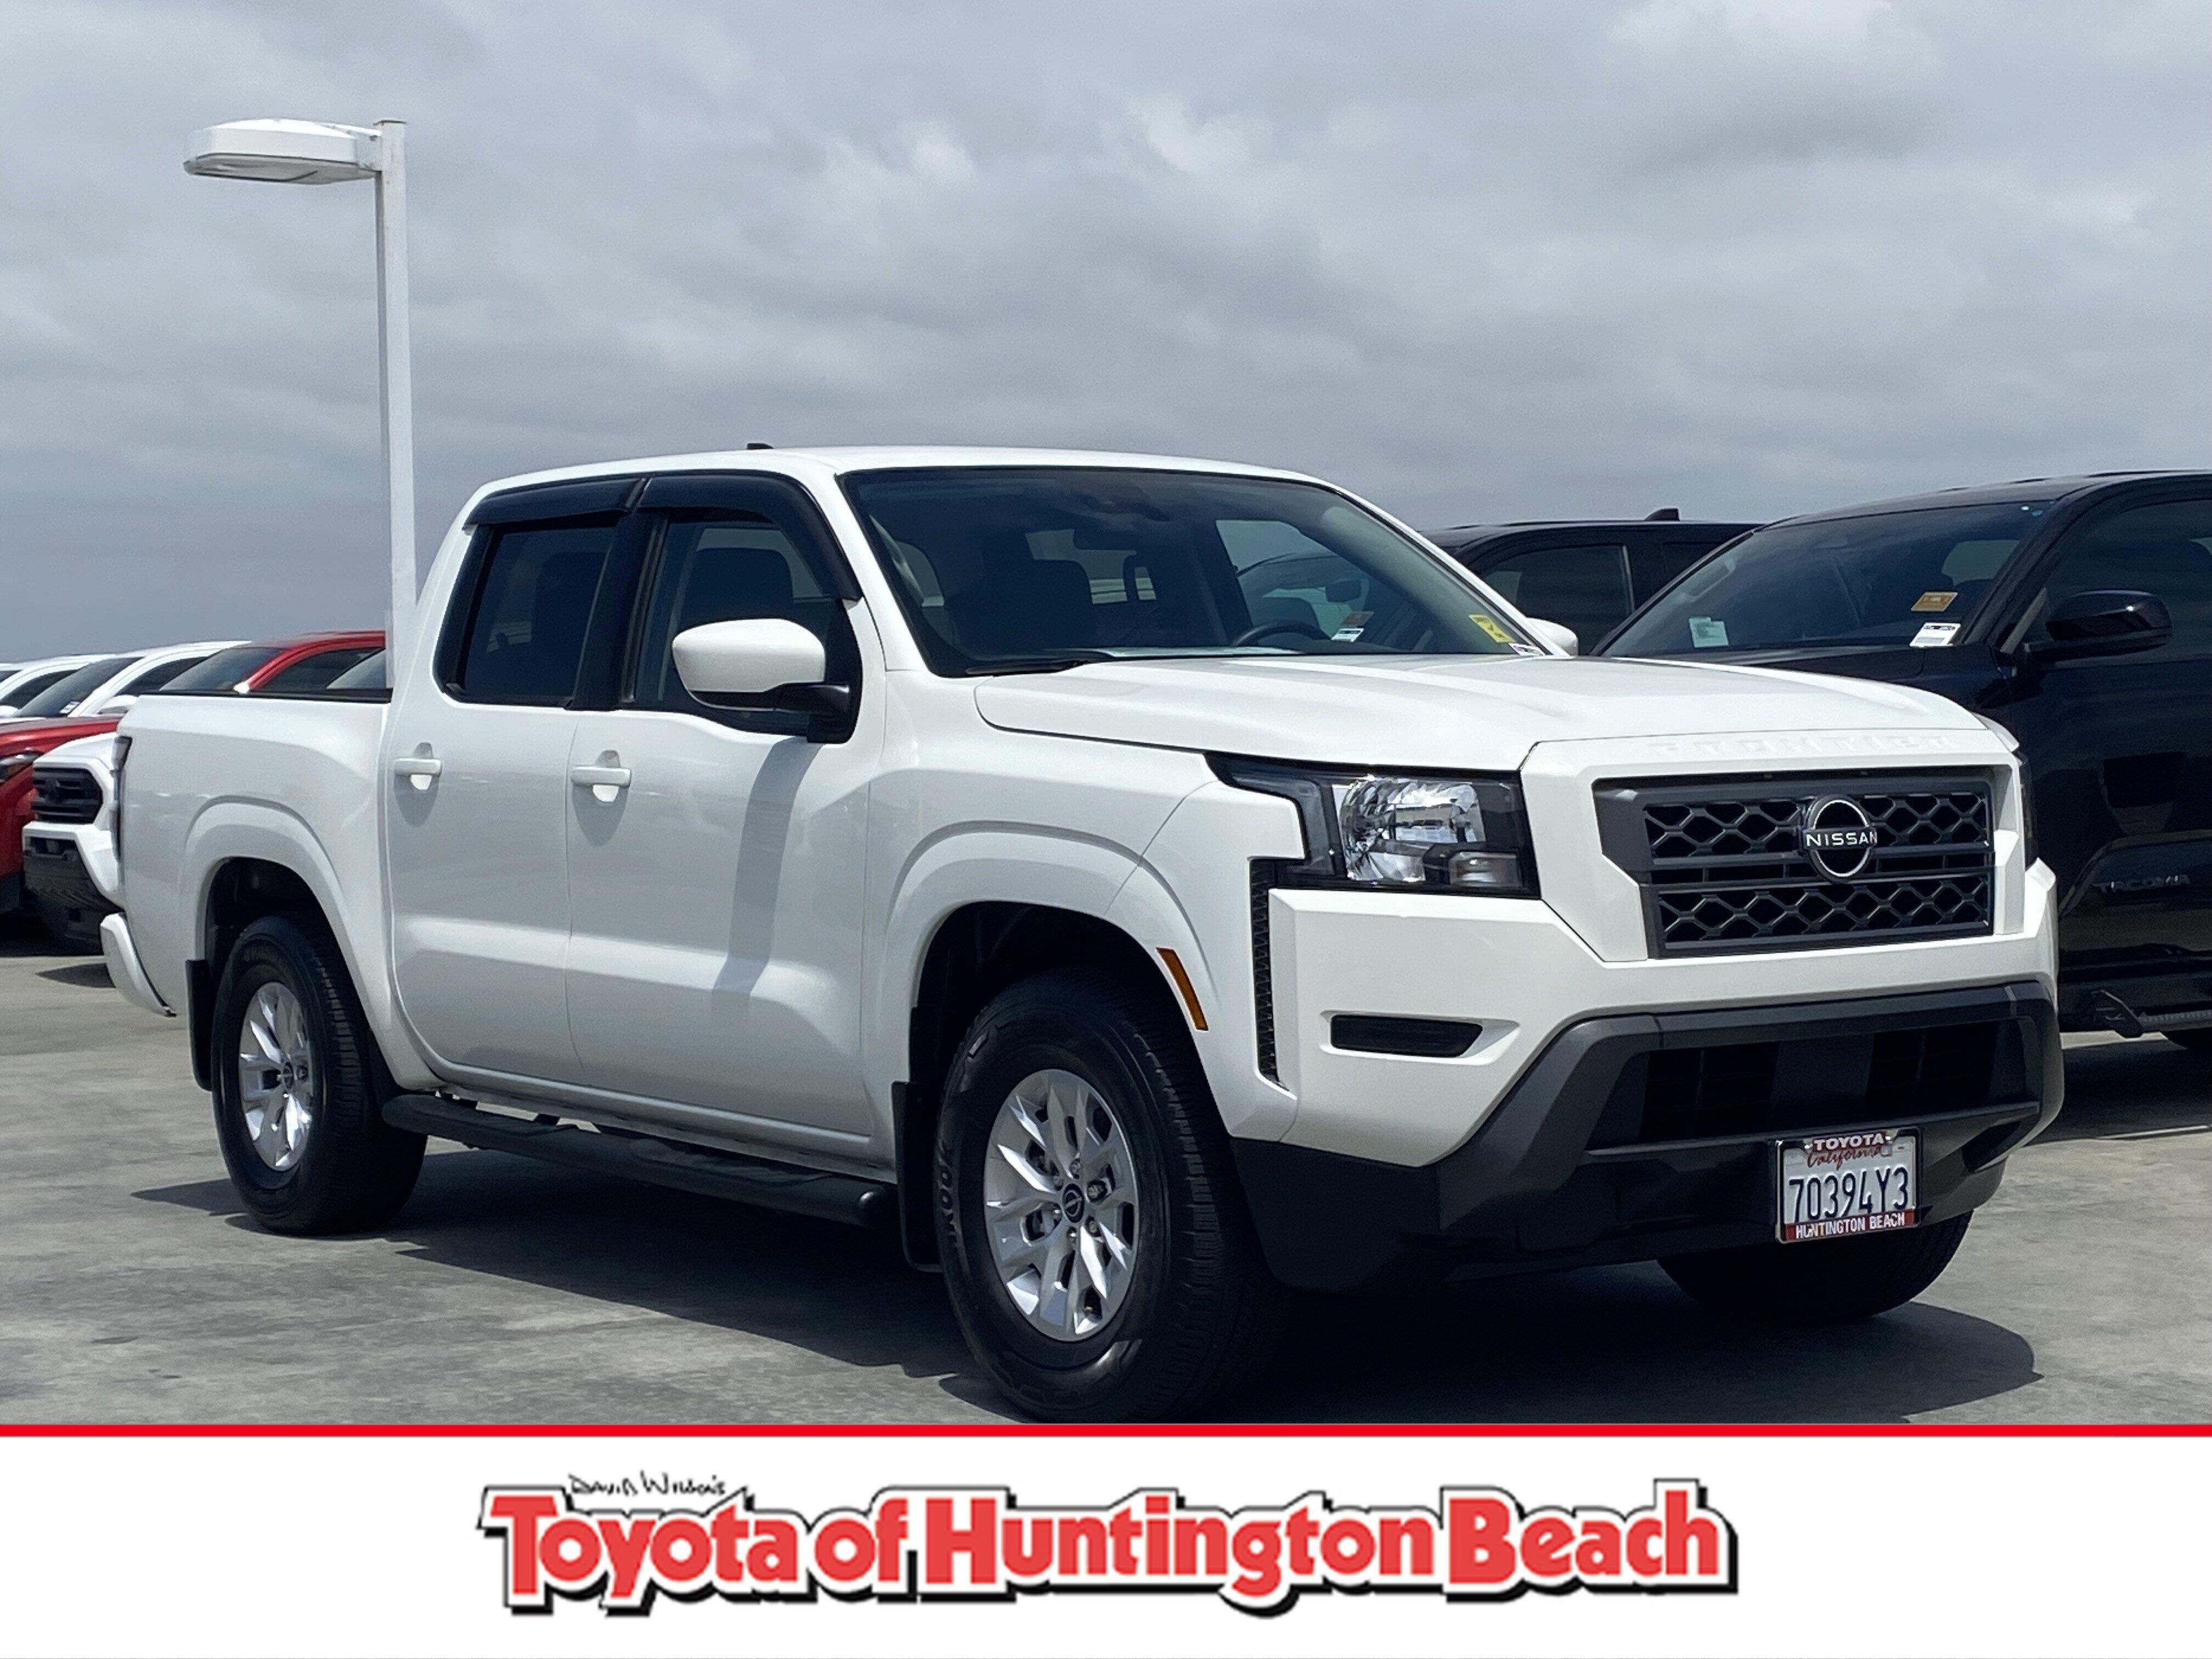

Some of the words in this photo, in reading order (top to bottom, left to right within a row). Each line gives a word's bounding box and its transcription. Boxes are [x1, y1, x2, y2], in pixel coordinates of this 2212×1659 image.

[1805, 831, 1878, 847] NISSAN
[1813, 1132, 1885, 1151] TOYOTA
[1788, 1166, 1909, 1223] 70394Y3
[1795, 1217, 1865, 1239] HUNTINGTON
[1869, 1212, 1905, 1229] BEACH
